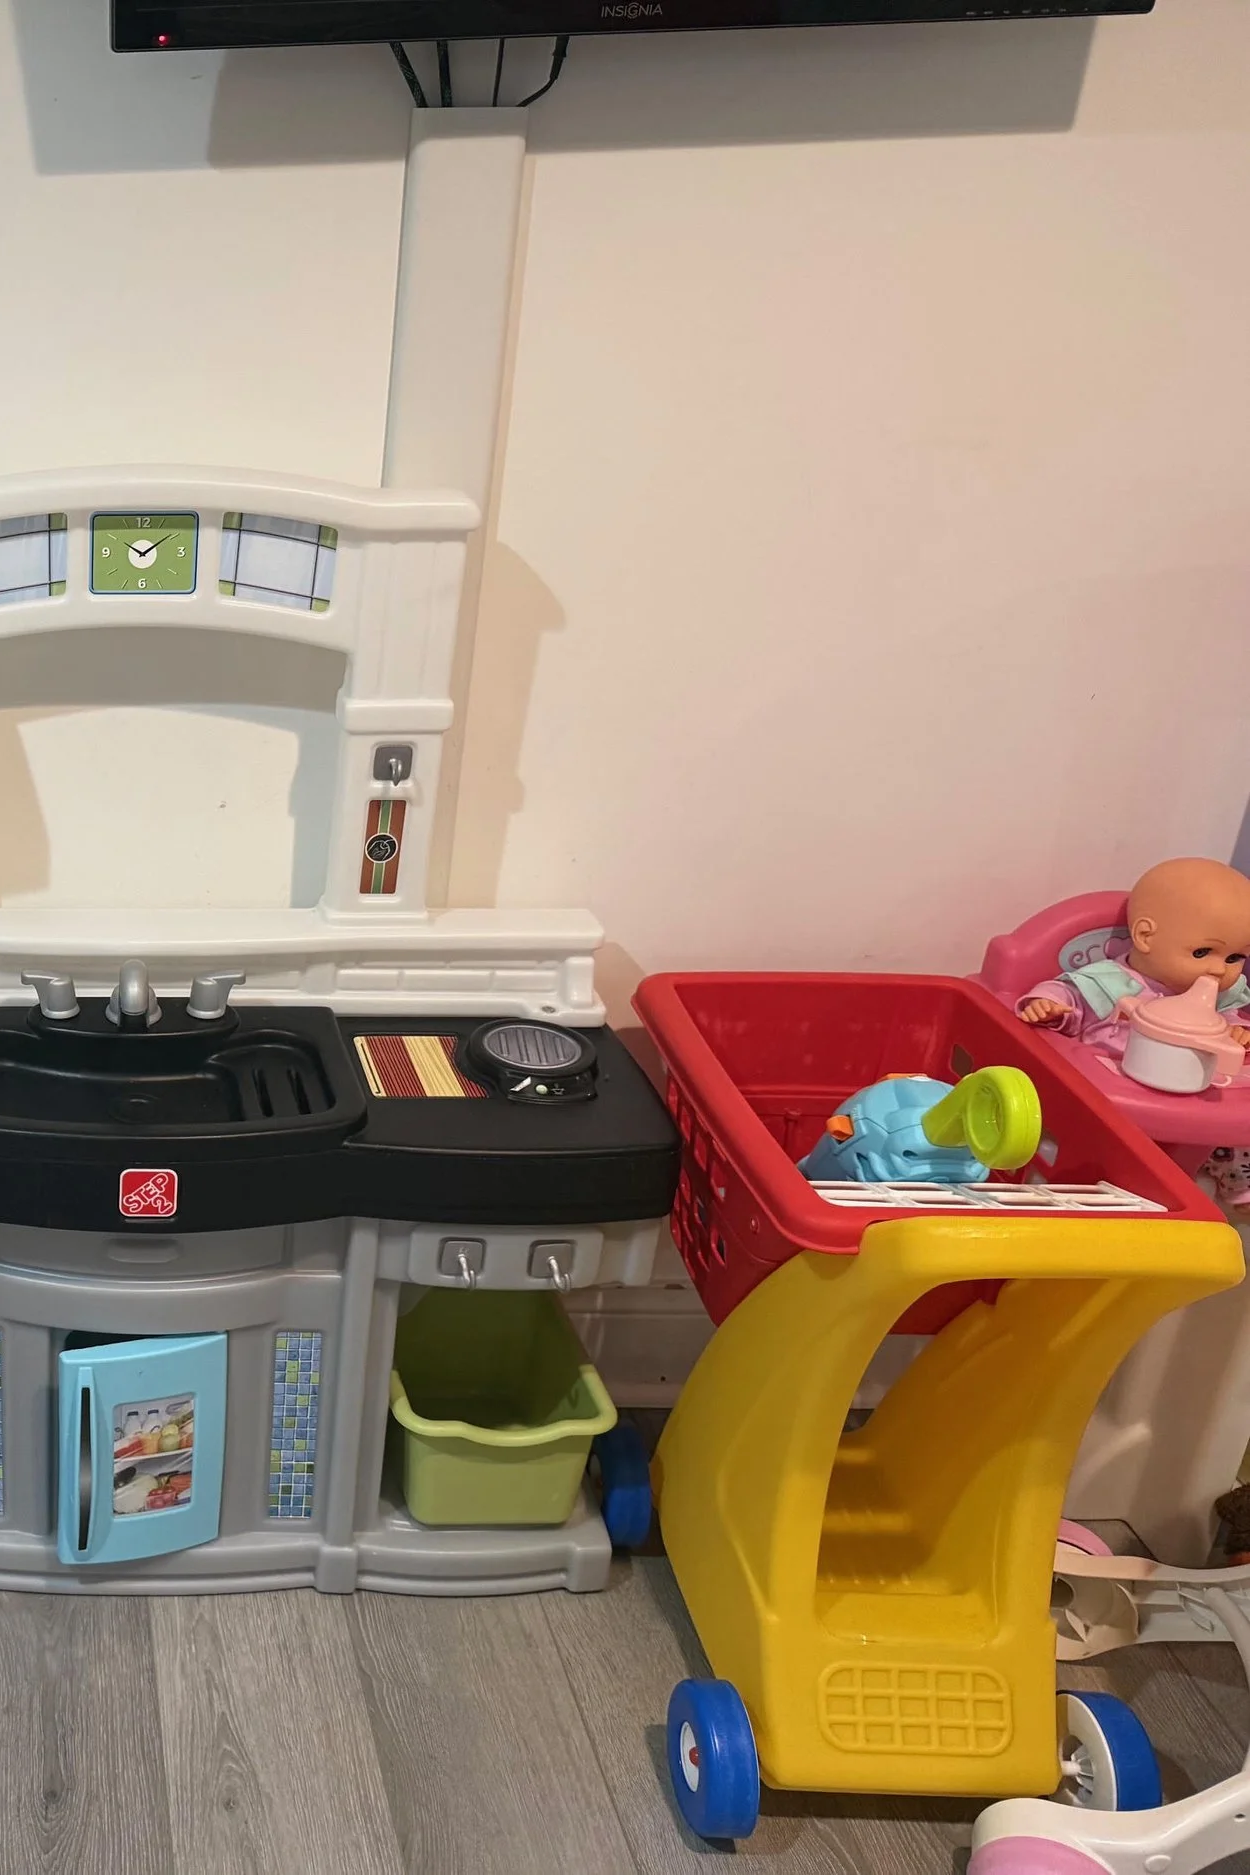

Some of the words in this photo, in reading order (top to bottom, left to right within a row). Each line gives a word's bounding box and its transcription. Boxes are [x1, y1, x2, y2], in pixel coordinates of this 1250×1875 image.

[600, 2, 663, 19] INSIGNIA
[135, 517, 151, 528] 12
[101, 547, 111, 558] 9
[176, 546, 186, 557] 3
[137, 578, 147, 589] 6
